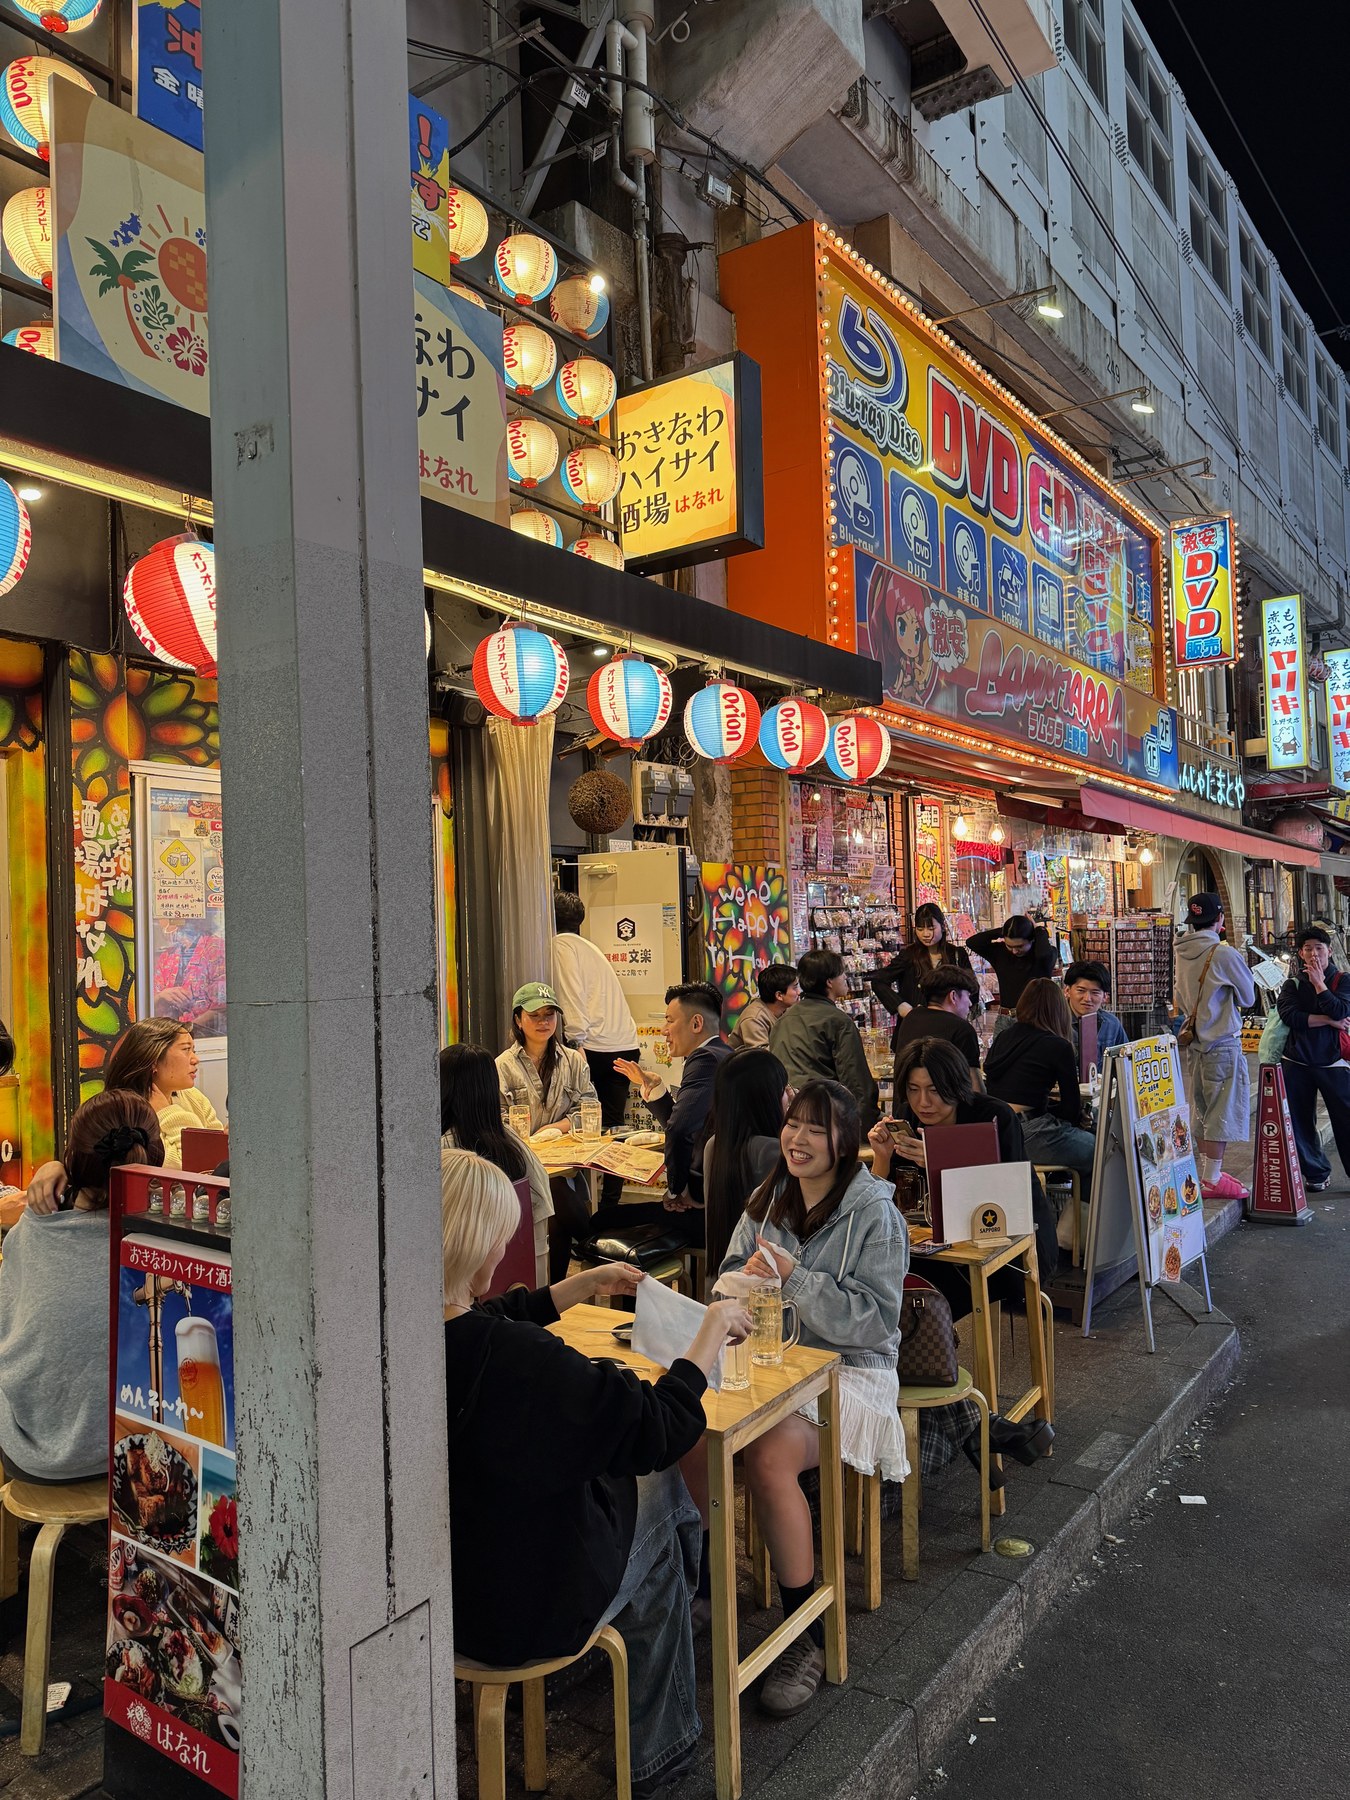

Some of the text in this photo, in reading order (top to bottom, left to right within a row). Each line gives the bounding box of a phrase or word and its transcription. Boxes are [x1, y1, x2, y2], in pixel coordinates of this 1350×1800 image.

[562, 361, 578, 400] Orion
[1105, 352, 1121, 384] 249
[508, 420, 527, 460] Orion
[617, 405, 724, 462] おきなわ
[889, 410, 920, 457] Disc
[620, 440, 720, 493] ハイサイ
[930, 374, 1078, 565] DVD CD
[675, 488, 725, 513] はなれ
[915, 542, 930, 560] DVD
[1181, 526, 1217, 554] 激安
[1184, 550, 1219, 640] DVD
[1001, 609, 1023, 631] HOBBY
[1283, 608, 1297, 646] もつ焼
[497, 636, 515, 695] オリオンビール
[1185, 637, 1221, 660] 販売
[607, 668, 621, 723] オリオンビール
[1269, 650, 1300, 716] ヤリキ
[722, 692, 746, 742] Orion
[779, 707, 801, 753] Orion
[1160, 718, 1169, 741] 2F
[837, 725, 856, 768] Orion
[1179, 759, 1245, 810] んじゃたまとや
[712, 906, 780, 946] Happy
[628, 948, 651, 963] 文楽
[1268, 1140, 1282, 1203] NO PARKING
[979, 1226, 1001, 1234] SAPPORO
[129, 1245, 232, 1289] おきなわハイサイ酒
[156, 1721, 212, 1775] はなれ
